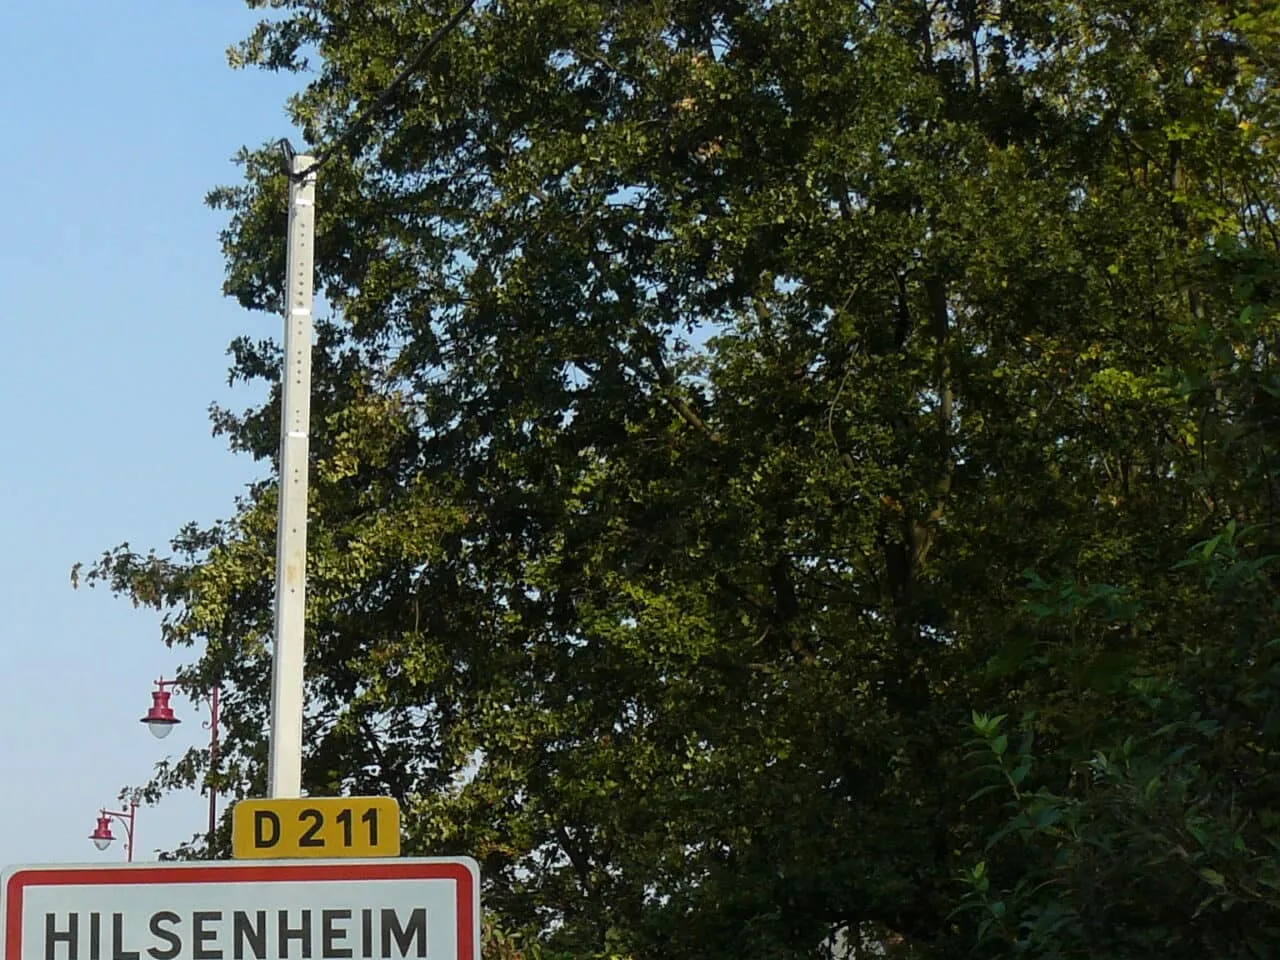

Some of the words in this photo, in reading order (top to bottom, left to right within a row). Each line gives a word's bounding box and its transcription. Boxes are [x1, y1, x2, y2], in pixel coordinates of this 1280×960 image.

[254, 810, 281, 849] D
[298, 808, 378, 848] 211
[45, 908, 428, 960] HILSENHEIM
